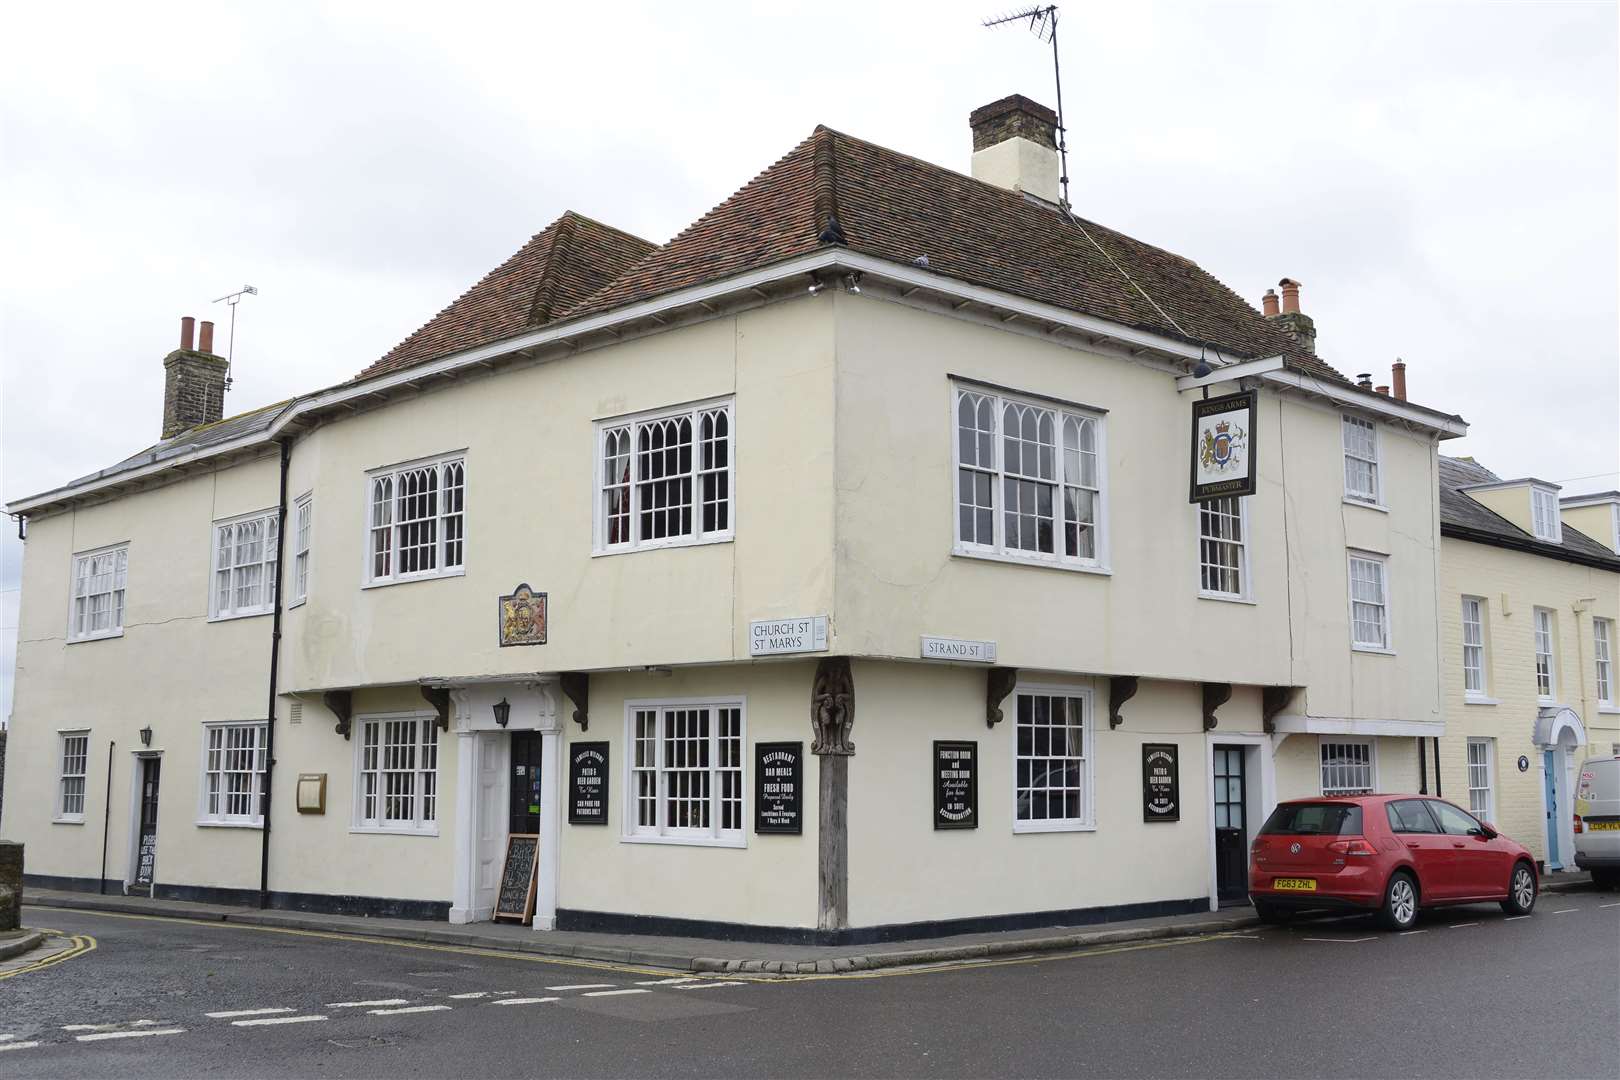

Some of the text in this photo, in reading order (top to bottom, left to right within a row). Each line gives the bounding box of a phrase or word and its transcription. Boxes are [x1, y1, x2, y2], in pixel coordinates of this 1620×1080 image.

[754, 623, 794, 637] CHURCH
[798, 622, 810, 633] ST
[754, 636, 802, 650] ST MARYS
[929, 642, 967, 655] STRAND
[969, 646, 979, 656] ST
[763, 752, 795, 764] RESTAURANT
[940, 751, 971, 759] FUNCTION ROOM
[765, 768, 792, 776] BAR MEALS
[941, 770, 970, 778] MEETING ROOM
[764, 784, 793, 792] FRESH FOOD
[940, 808, 972, 820] ACCOMMODATION
[1276, 880, 1312, 888] FG63 ZHL
